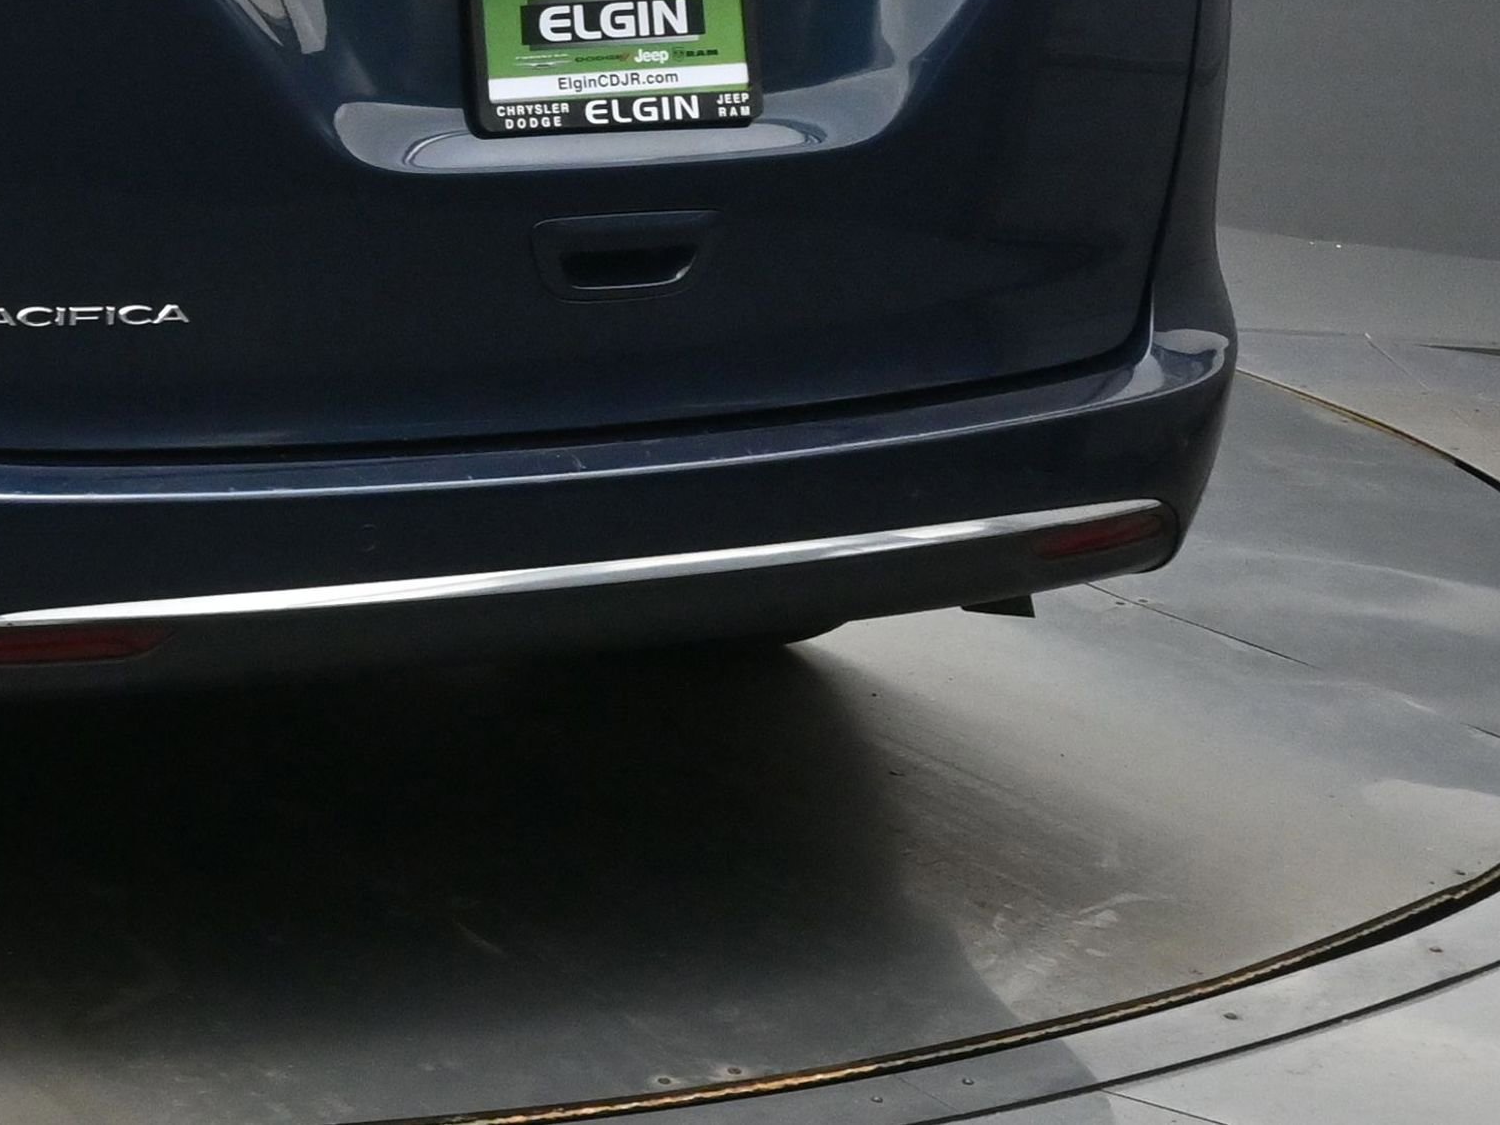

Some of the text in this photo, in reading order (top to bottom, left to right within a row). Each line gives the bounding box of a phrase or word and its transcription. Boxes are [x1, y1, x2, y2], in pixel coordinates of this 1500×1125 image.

[634, 48, 669, 64] Jeep
[557, 71, 679, 93] ElginCDJR.com
[716, 92, 750, 105] JEEP
[496, 102, 570, 117] CHRYSLER
[585, 94, 700, 125] ELGIN
[718, 105, 751, 117] RAM
[505, 116, 562, 130] DODGE
